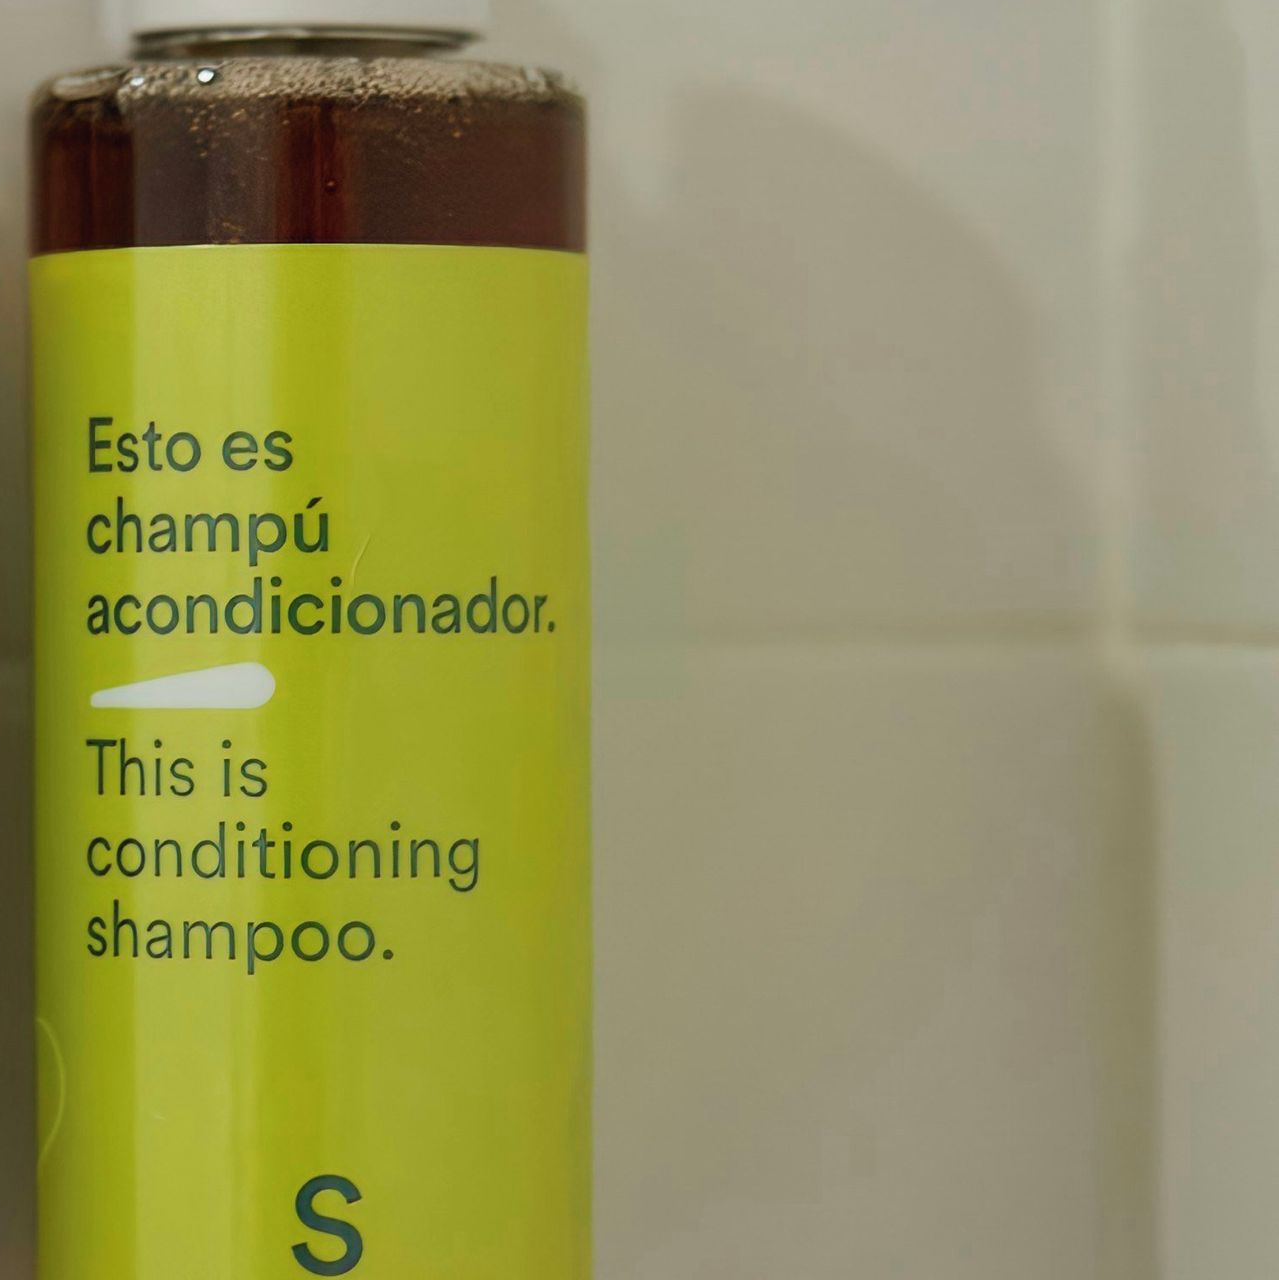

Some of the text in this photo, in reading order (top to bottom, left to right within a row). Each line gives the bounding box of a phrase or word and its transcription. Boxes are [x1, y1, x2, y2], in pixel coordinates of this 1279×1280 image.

[85, 415, 294, 476] Esto es
[84, 495, 330, 568] champú
[84, 575, 557, 636] acondicionador.
[84, 735, 268, 798] This is
[85, 820, 480, 894] conditioning
[82, 898, 395, 976] shampoo.
[290, 1173, 365, 1278] S
